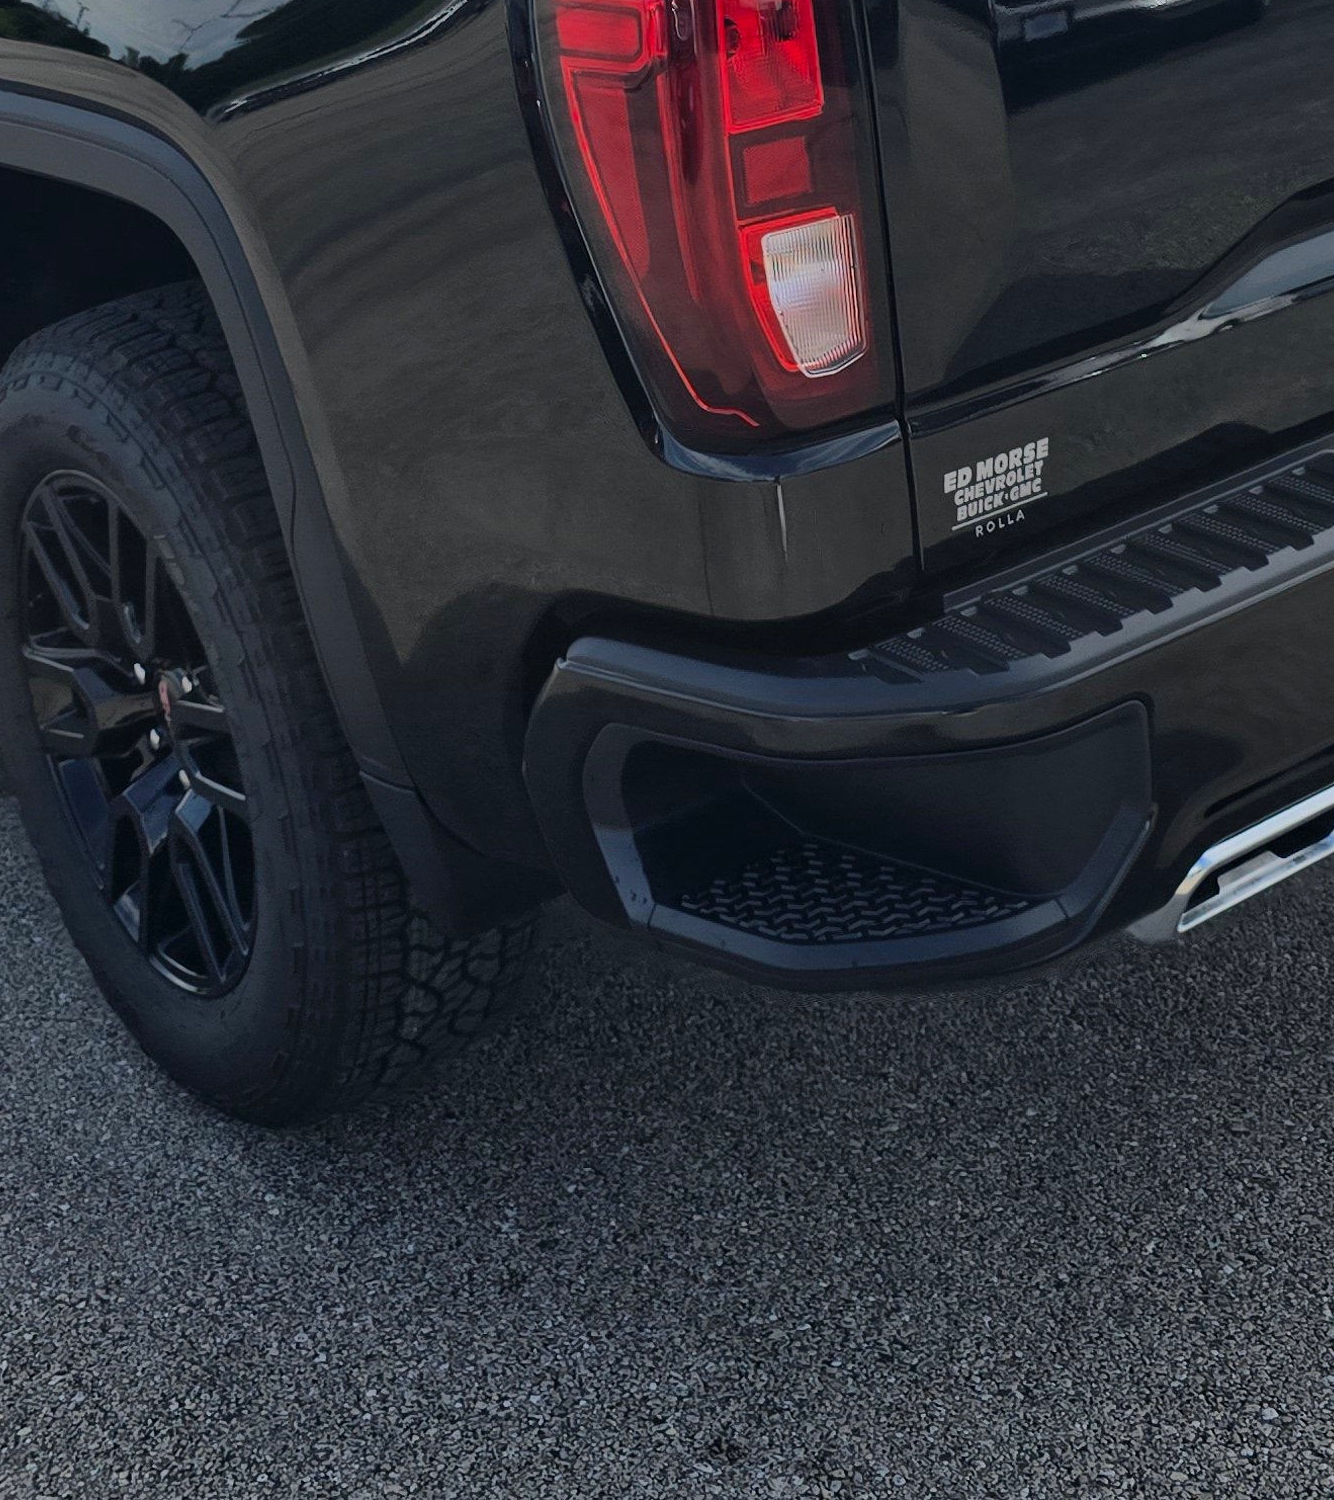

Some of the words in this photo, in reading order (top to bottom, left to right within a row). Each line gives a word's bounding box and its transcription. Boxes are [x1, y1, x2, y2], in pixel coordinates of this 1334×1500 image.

[944, 466, 973, 494] ED
[976, 437, 1049, 482] MORSE
[954, 460, 1044, 506] CHEVROLET
[975, 509, 1025, 537] ROLLA
